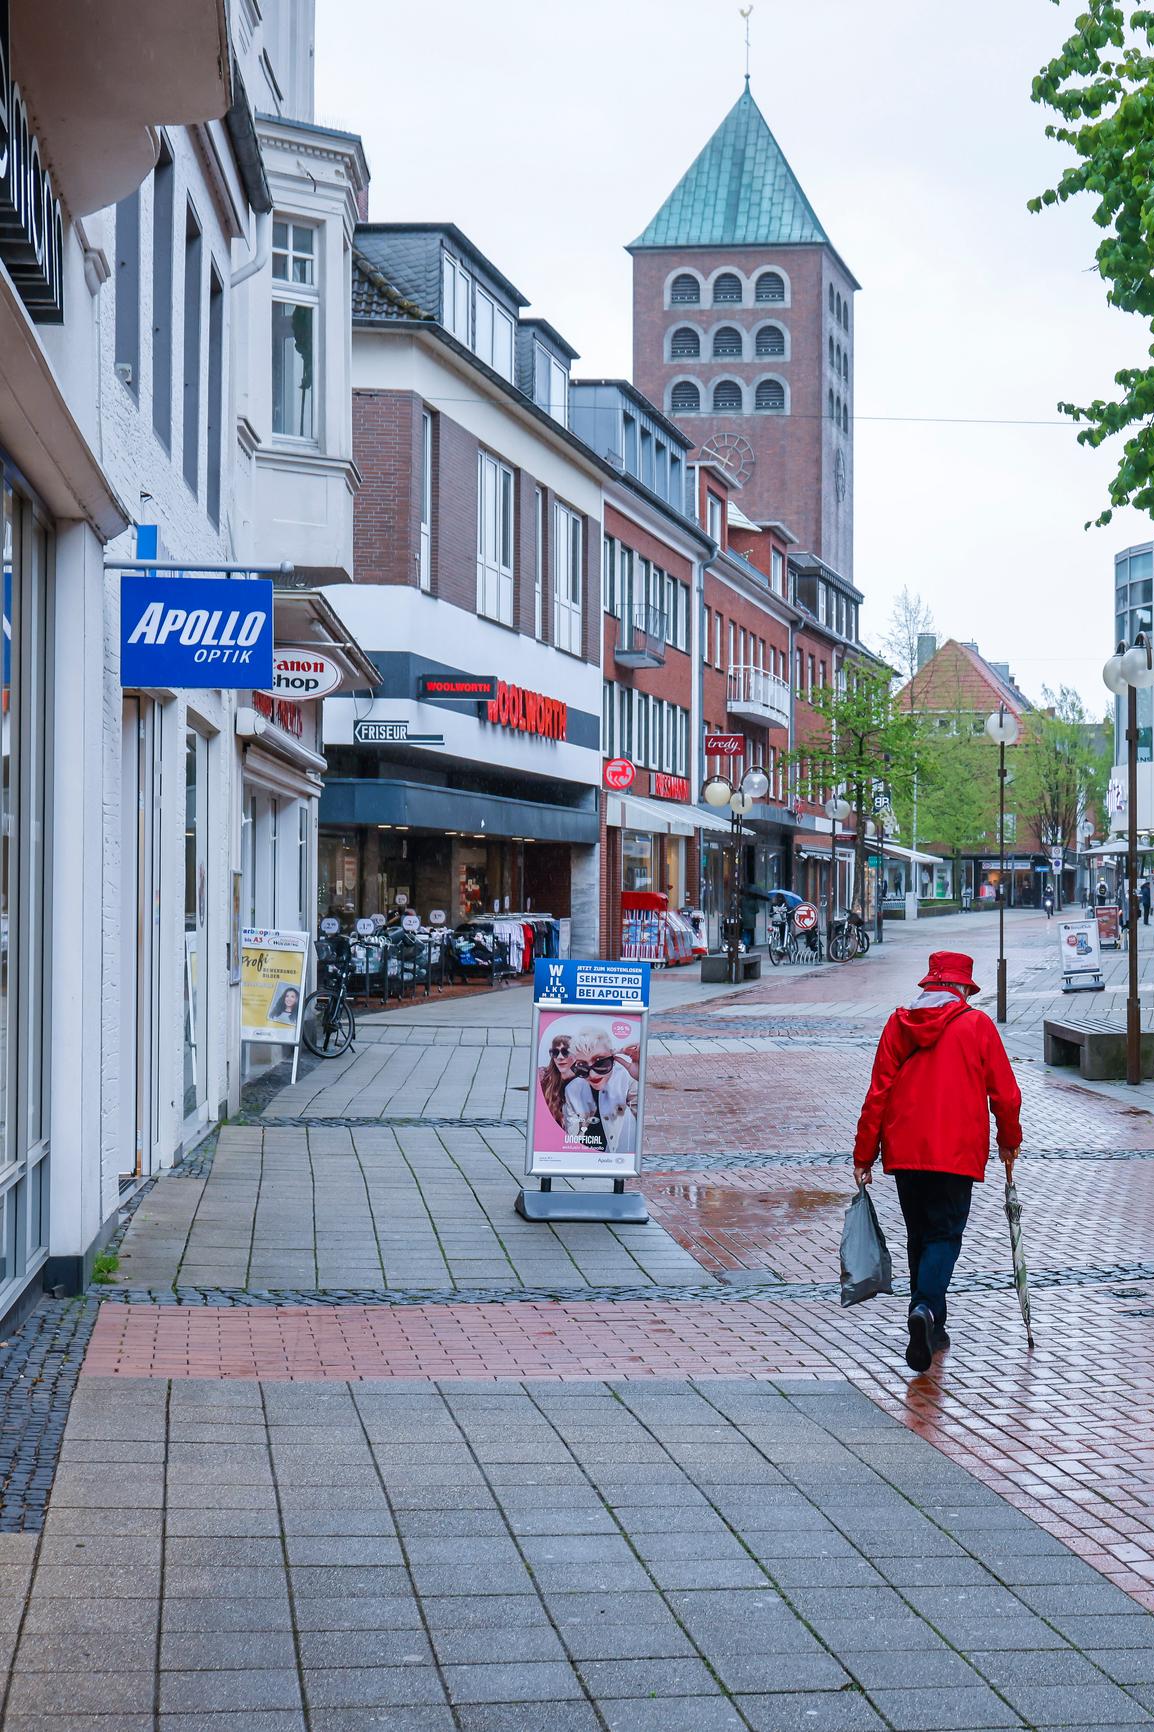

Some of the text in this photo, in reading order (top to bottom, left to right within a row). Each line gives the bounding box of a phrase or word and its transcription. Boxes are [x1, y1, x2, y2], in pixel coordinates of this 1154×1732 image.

[127, 602, 266, 647] APOLLO
[193, 649, 254, 664] OPTIK
[273, 658, 325, 673] anon
[425, 682, 491, 692] WOOLWORTH
[487, 680, 568, 741] WOOLWORTH
[361, 724, 408, 740] FRISEUR
[707, 737, 741, 753] tredy
[579, 975, 640, 985] SEHTEST PRO
[578, 988, 639, 999] BEI APOLLO
[564, 1135, 603, 1145] UNOFFICIAL
